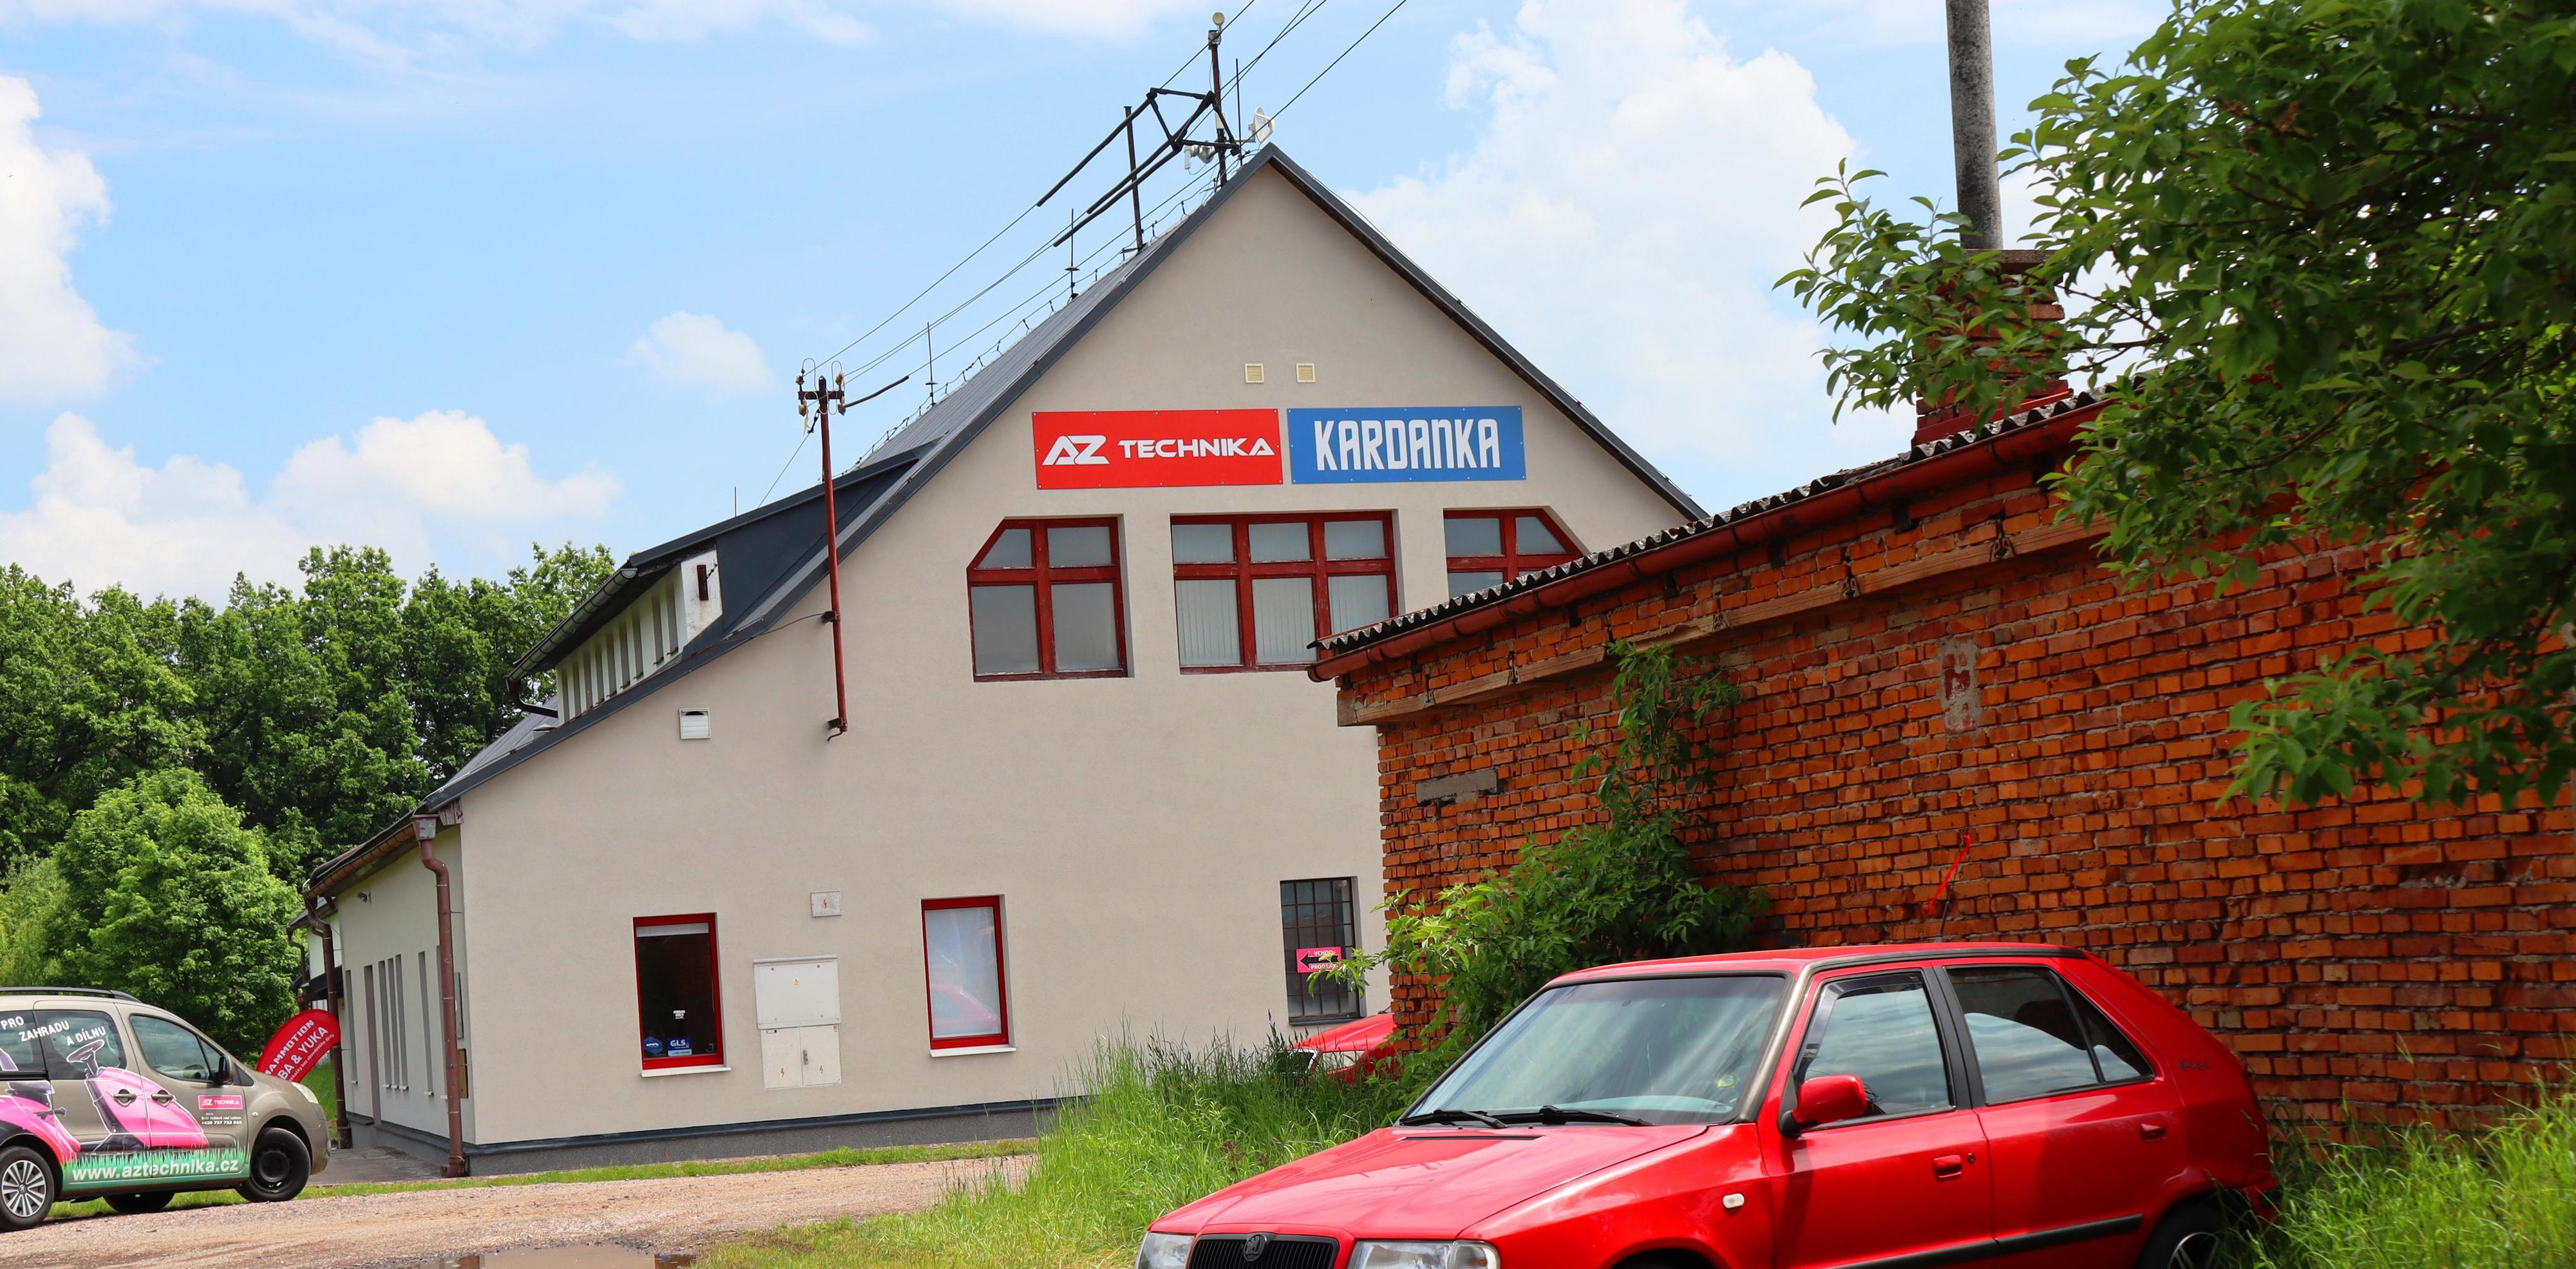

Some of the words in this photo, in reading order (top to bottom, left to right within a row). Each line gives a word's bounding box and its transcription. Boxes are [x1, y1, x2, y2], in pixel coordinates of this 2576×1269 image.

[1041, 435, 1110, 466] AZ
[1118, 437, 1276, 459] TECHNIKA
[1314, 418, 1501, 471] KARDANKA
[1, 1016, 24, 1030] PRO
[19, 1020, 70, 1042] ZAHRADU
[66, 1036, 75, 1045] A
[75, 1026, 106, 1043] DÍLNU
[276, 1064, 295, 1080] BA
[290, 1054, 303, 1064] &
[298, 1026, 328, 1054] YUKA
[73, 1159, 238, 1181] www.aztechnika.cz
